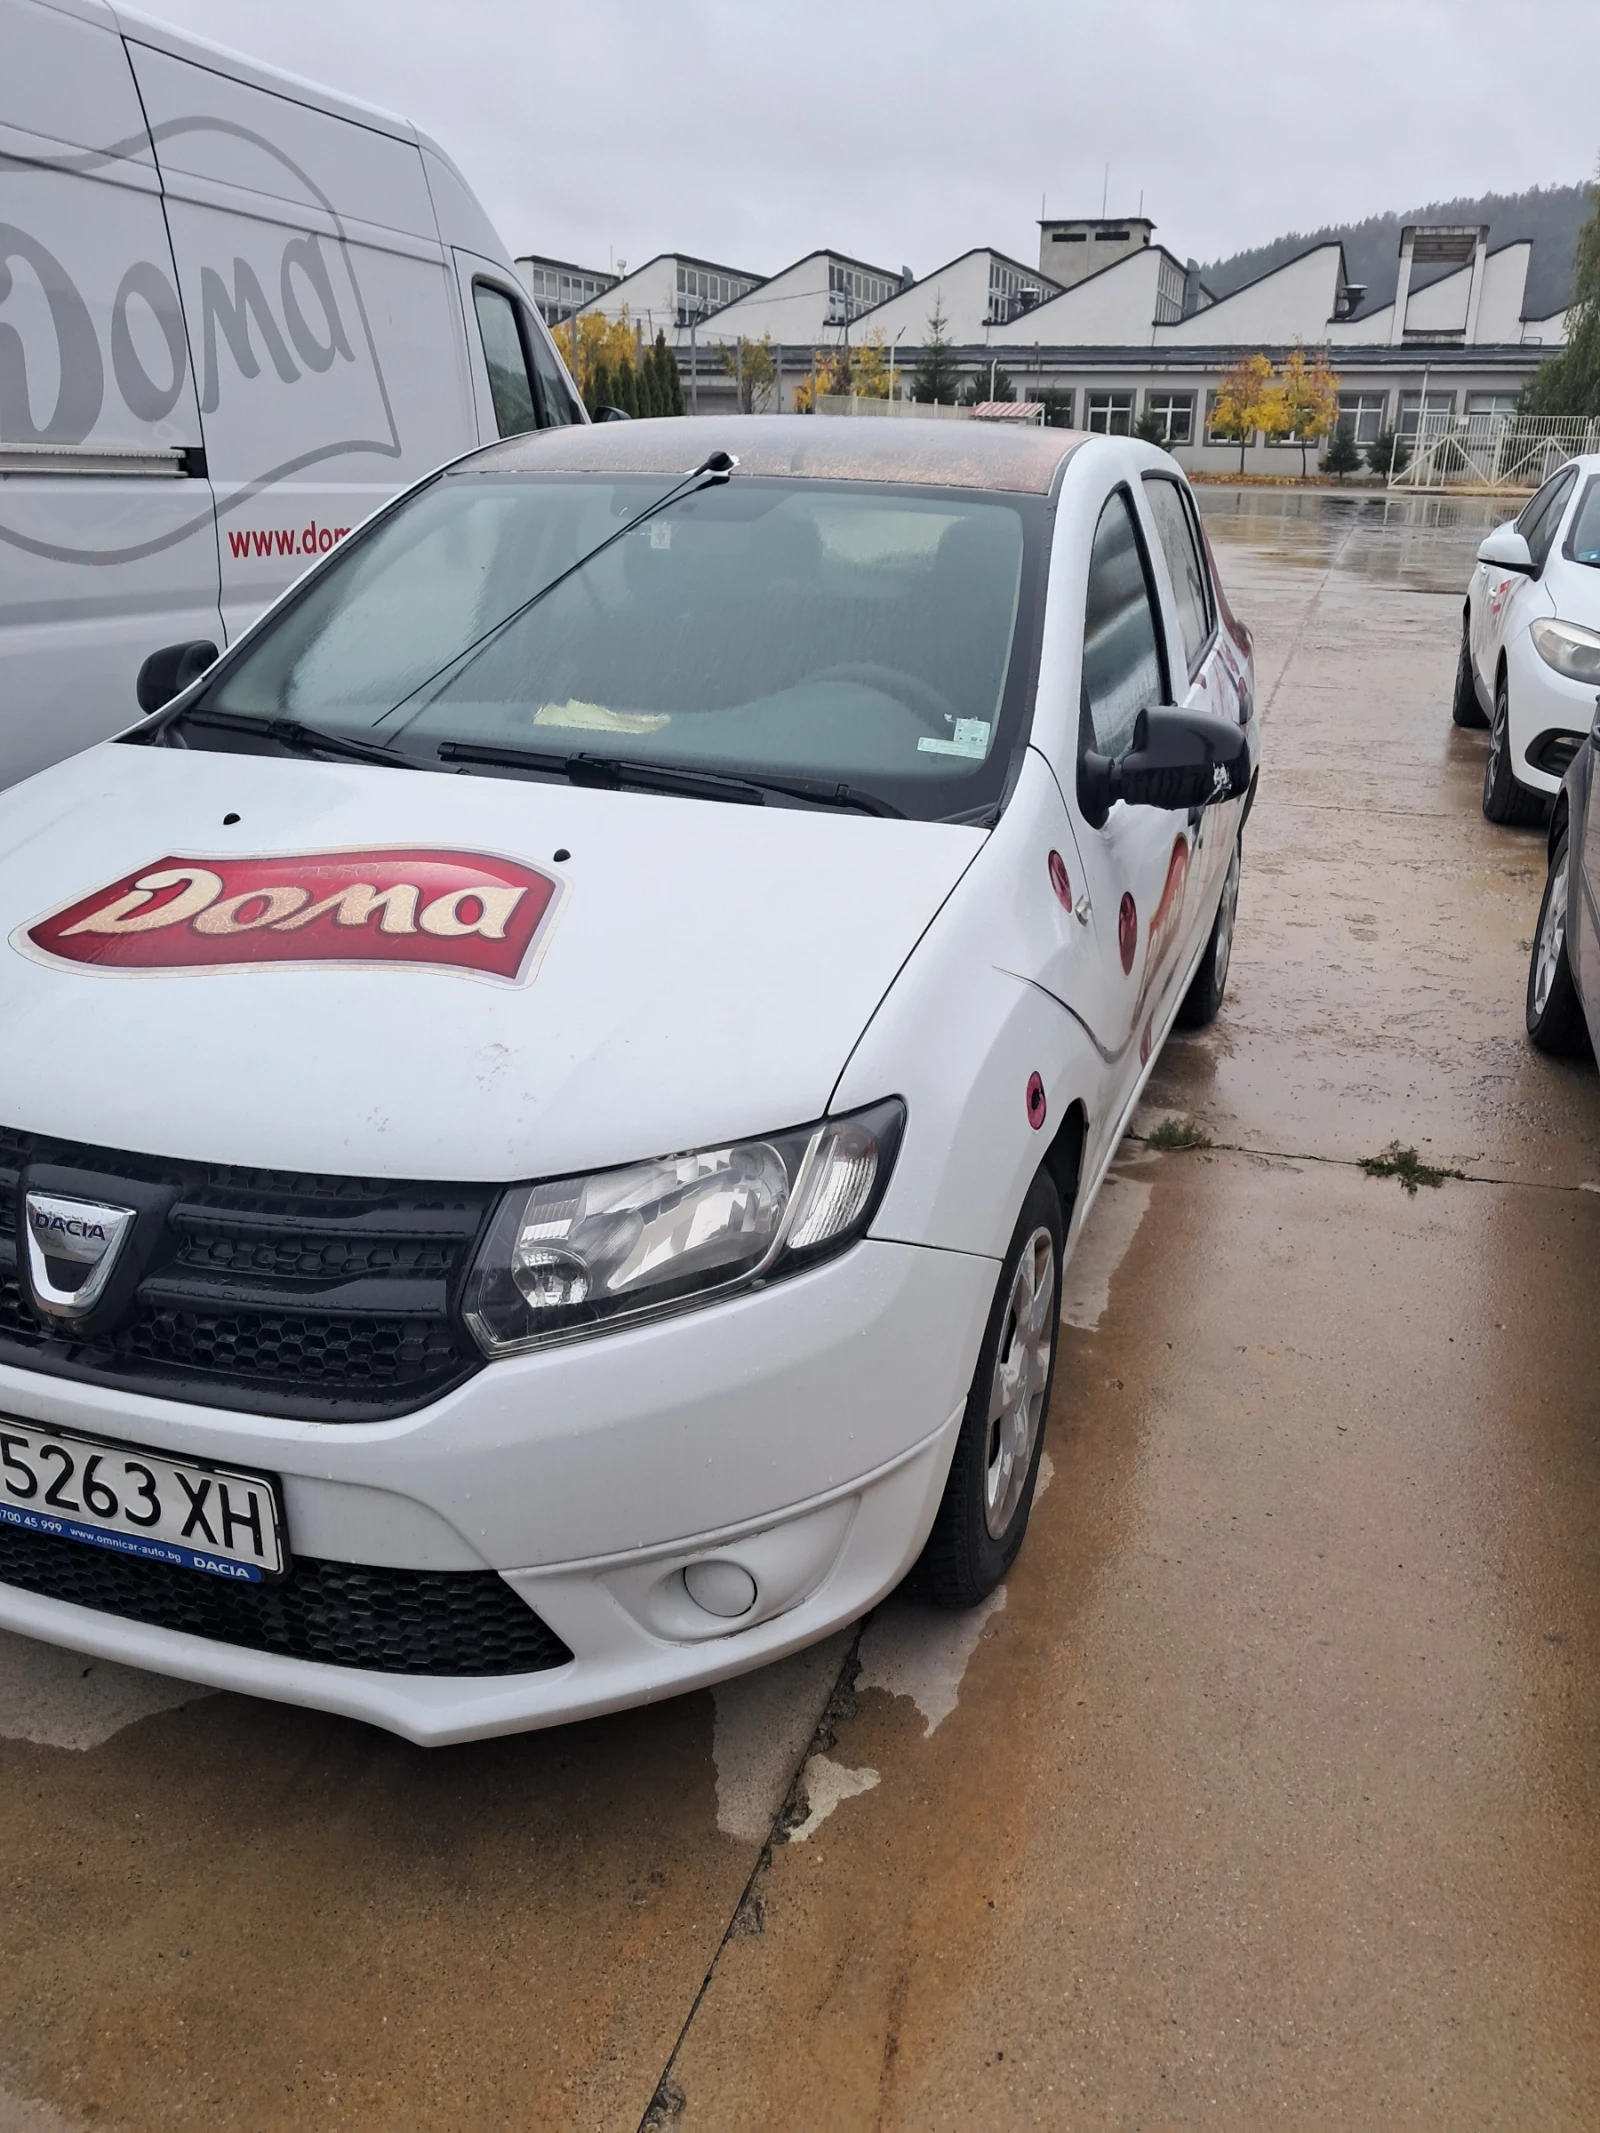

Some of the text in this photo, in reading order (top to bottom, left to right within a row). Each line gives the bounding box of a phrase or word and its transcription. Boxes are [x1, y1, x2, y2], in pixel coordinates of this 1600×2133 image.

[35, 1213, 105, 1241] DACIA
[0, 1433, 264, 1557] 5263 XH
[0, 1509, 250, 1579] 700 45 999 www.omnicar-auto.bg DACIA
